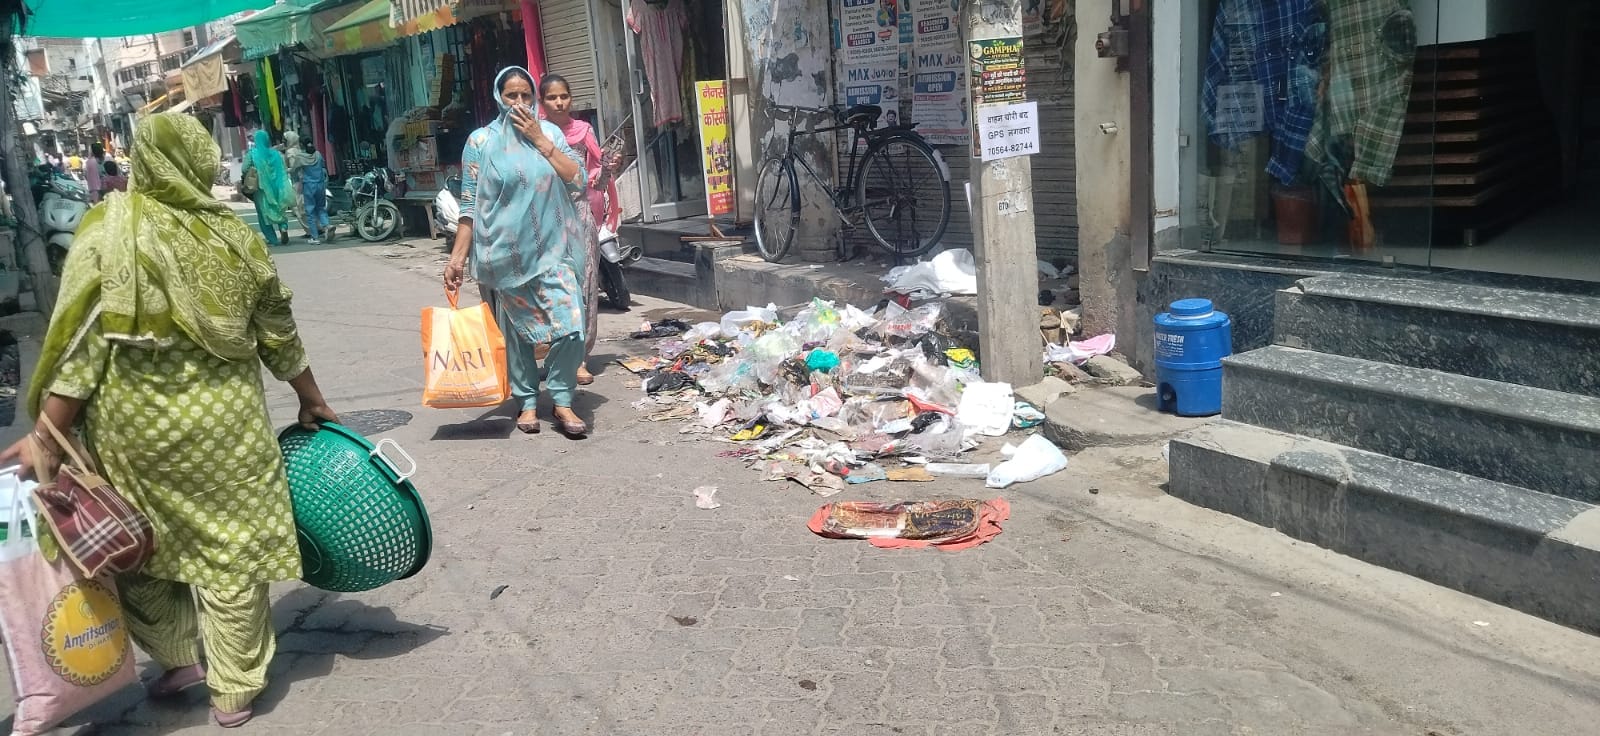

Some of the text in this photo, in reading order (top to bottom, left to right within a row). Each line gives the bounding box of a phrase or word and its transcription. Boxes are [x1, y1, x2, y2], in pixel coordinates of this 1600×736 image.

[918, 53, 943, 68] MAX
[848, 68, 870, 81] MAX
[917, 72, 952, 83] ADMISSION
[847, 87, 878, 97] ADMISSION
[927, 82, 943, 92] OPEN
[856, 95, 871, 104] OPEN
[987, 130, 1004, 140] GPS
[987, 141, 1033, 155] 70564-82744
[433, 347, 486, 372] NARI
